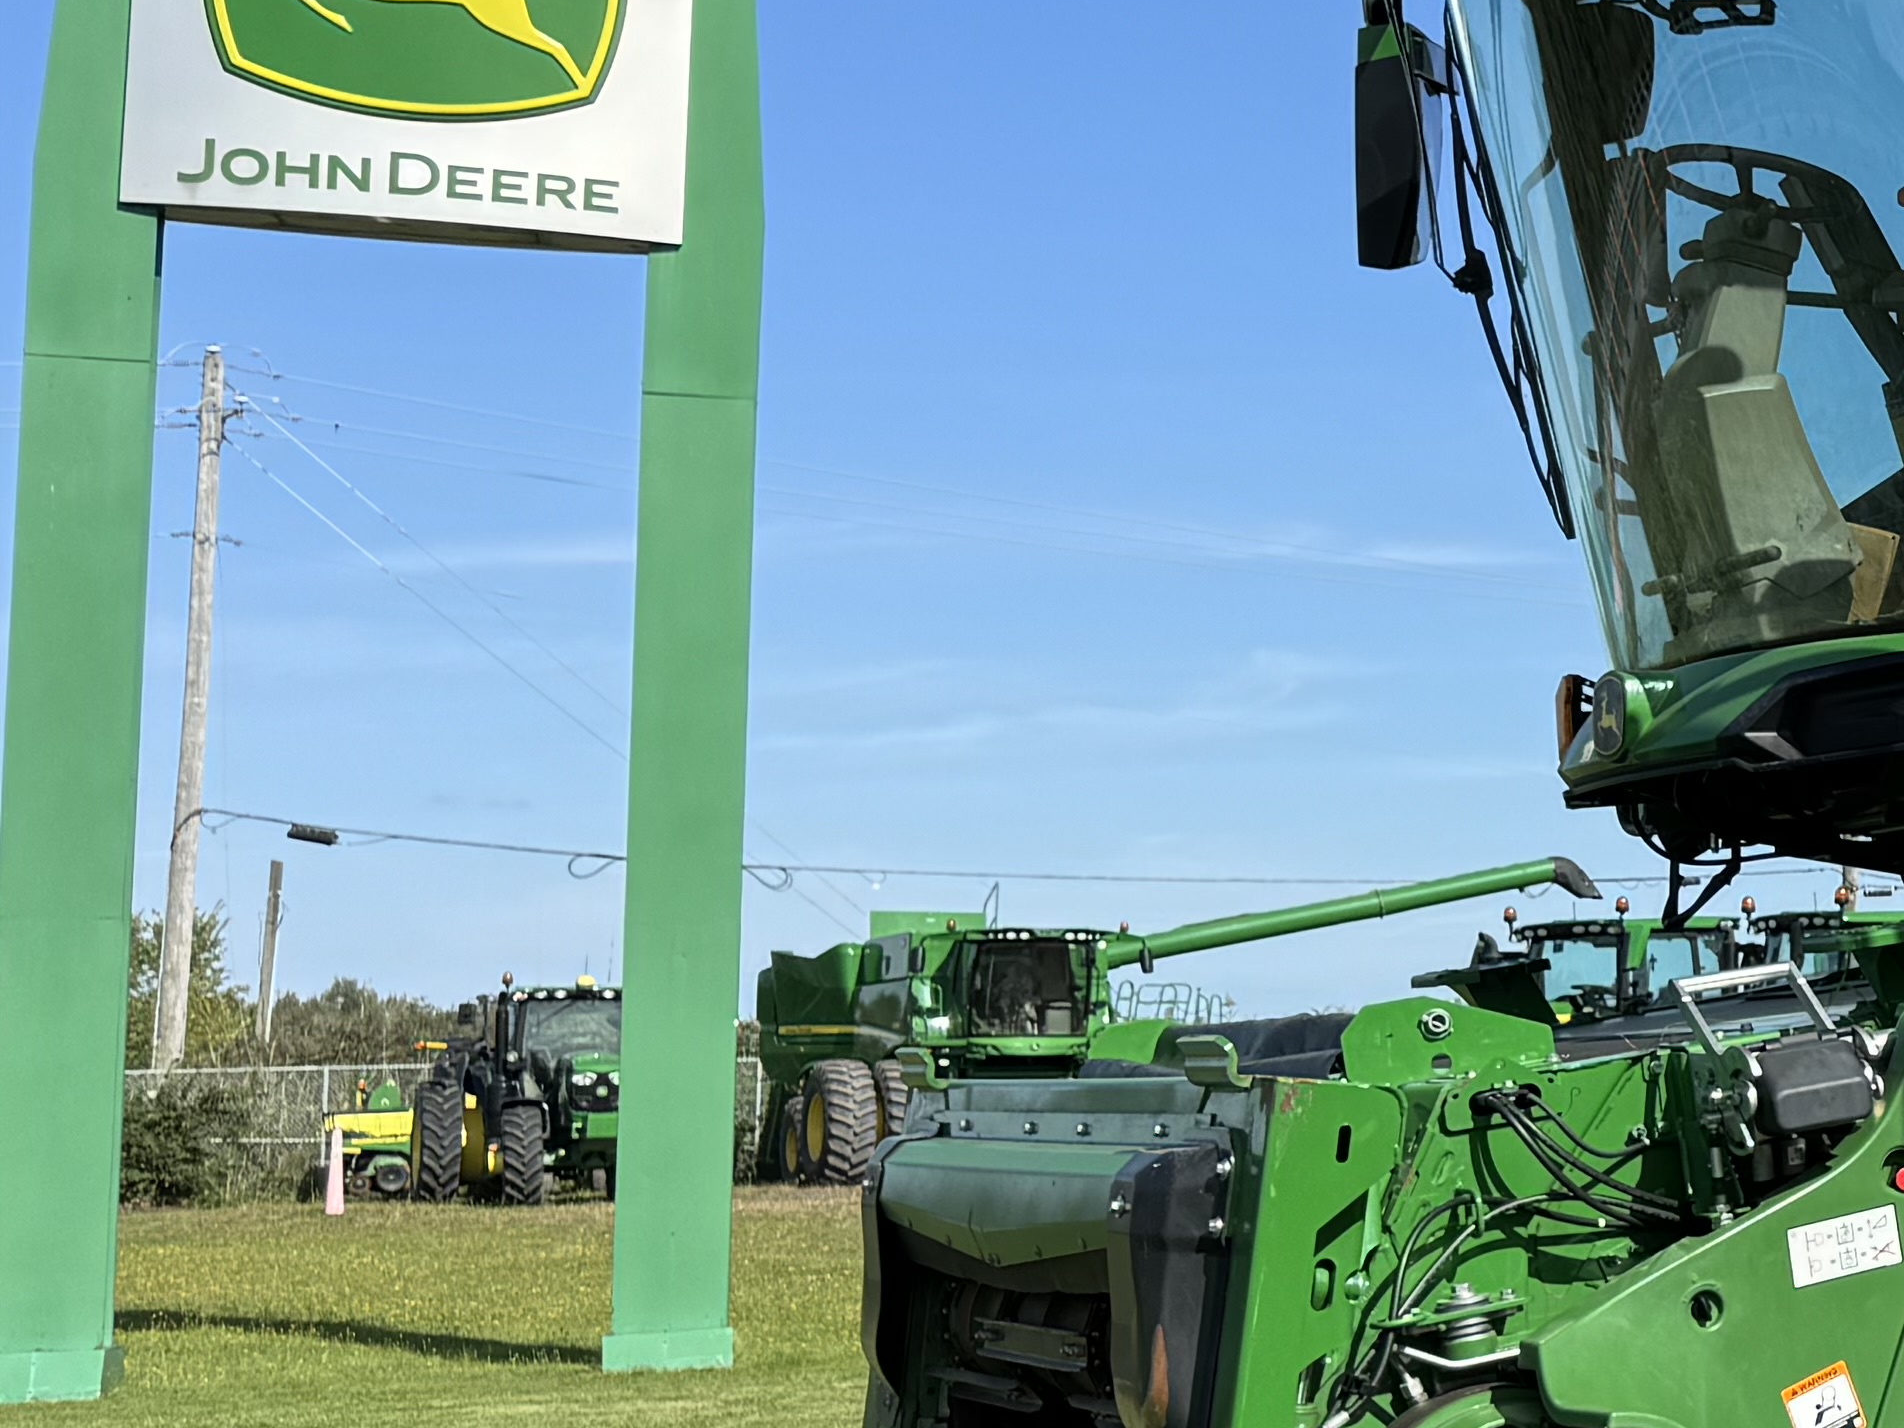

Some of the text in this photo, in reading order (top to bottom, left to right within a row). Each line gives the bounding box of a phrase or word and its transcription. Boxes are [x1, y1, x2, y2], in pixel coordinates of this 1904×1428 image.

[177, 138, 620, 214] JOHN DEERE
[1799, 1367, 1838, 1392] WARNING
